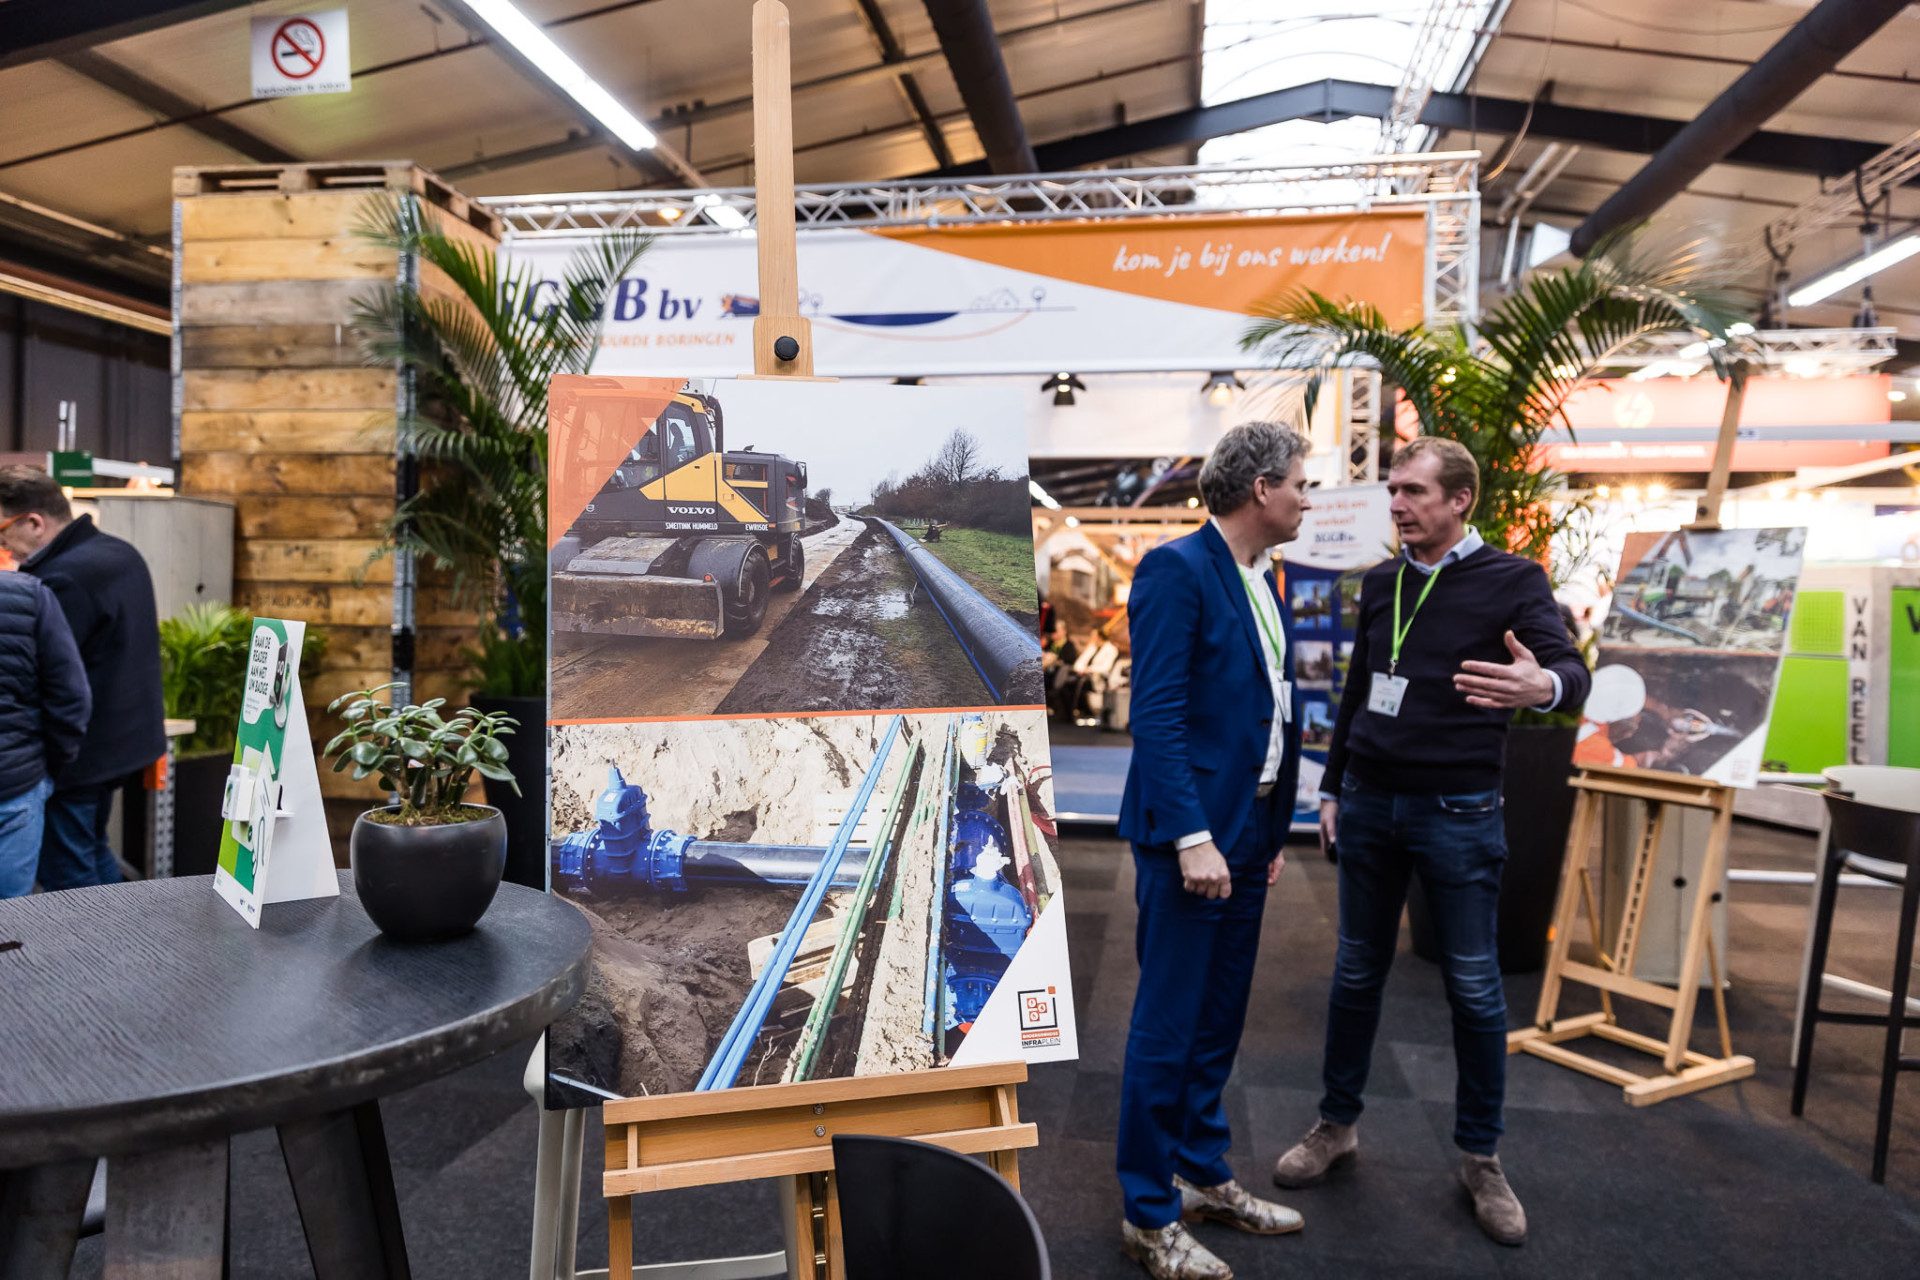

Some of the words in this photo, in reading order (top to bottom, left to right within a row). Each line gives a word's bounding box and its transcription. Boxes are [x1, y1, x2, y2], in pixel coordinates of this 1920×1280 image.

[1112, 244, 1163, 272] kom
[1163, 246, 1191, 278] je
[1199, 241, 1233, 277] bij
[1237, 248, 1282, 268] ons
[1289, 232, 1393, 266] werken!
[658, 288, 703, 320] bv
[656, 332, 735, 347] BORINGEN
[667, 506, 716, 515] VOLVO
[1851, 597, 1868, 660] VAN
[1021, 1038, 1061, 1047] INFRAPLEIN
